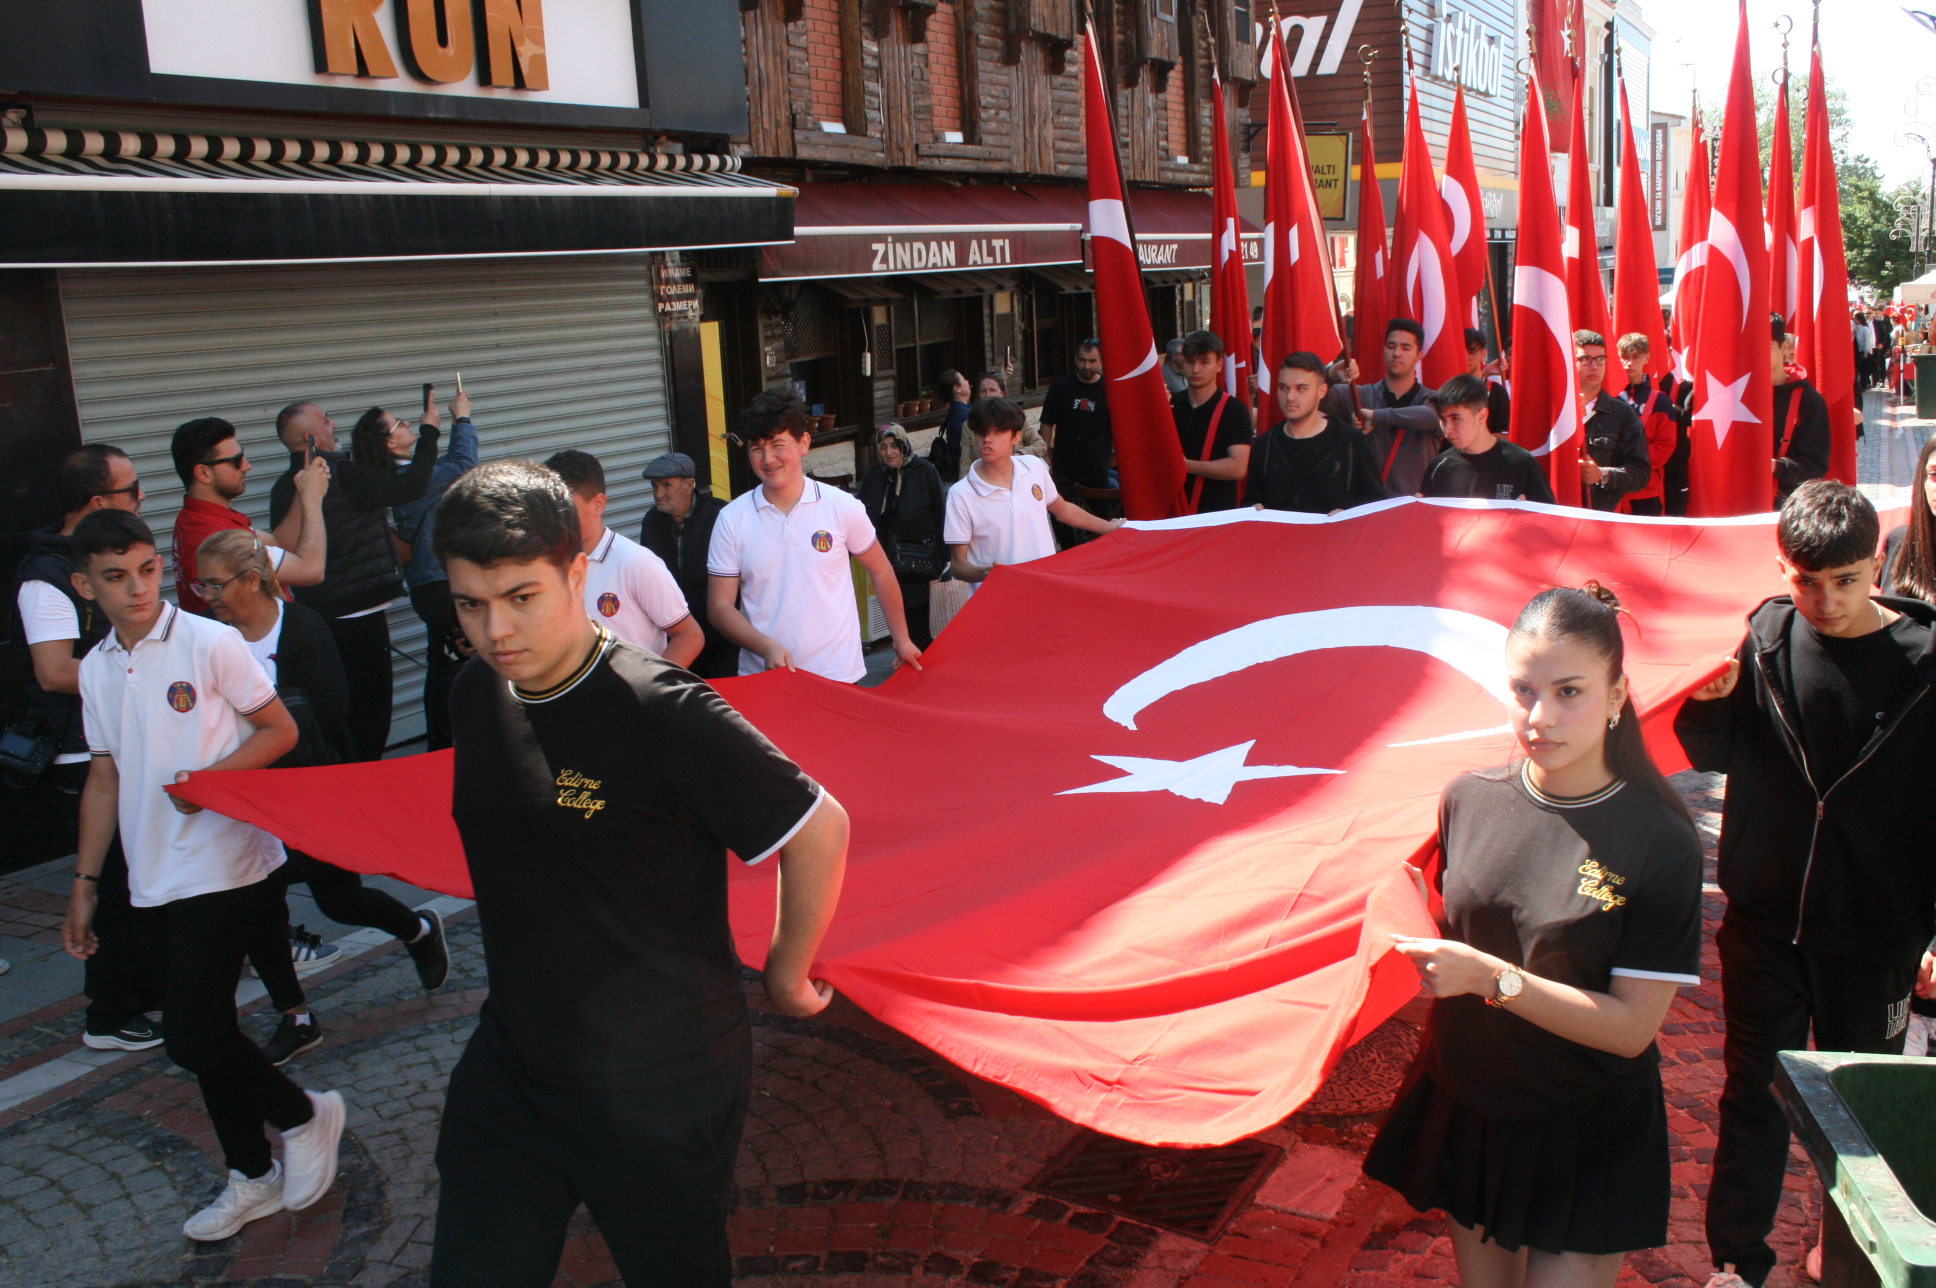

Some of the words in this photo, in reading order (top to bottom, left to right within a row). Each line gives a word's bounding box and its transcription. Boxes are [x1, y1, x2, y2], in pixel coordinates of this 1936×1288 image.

[1430, 0, 1504, 97] istikbal
[871, 235, 956, 271] ZİNDAN
[968, 238, 1011, 265] ALTI
[1136, 243, 1179, 265] AURANT
[1249, 241, 1259, 260] 49
[660, 267, 692, 278] ИМАМЕ
[660, 283, 695, 295] ГОЛЕМИ
[658, 299, 699, 313] РАЗМЕРИ
[556, 769, 602, 789] Edirne
[557, 789, 606, 819] College
[1578, 859, 1626, 885] Edirne
[1577, 877, 1627, 912] College
